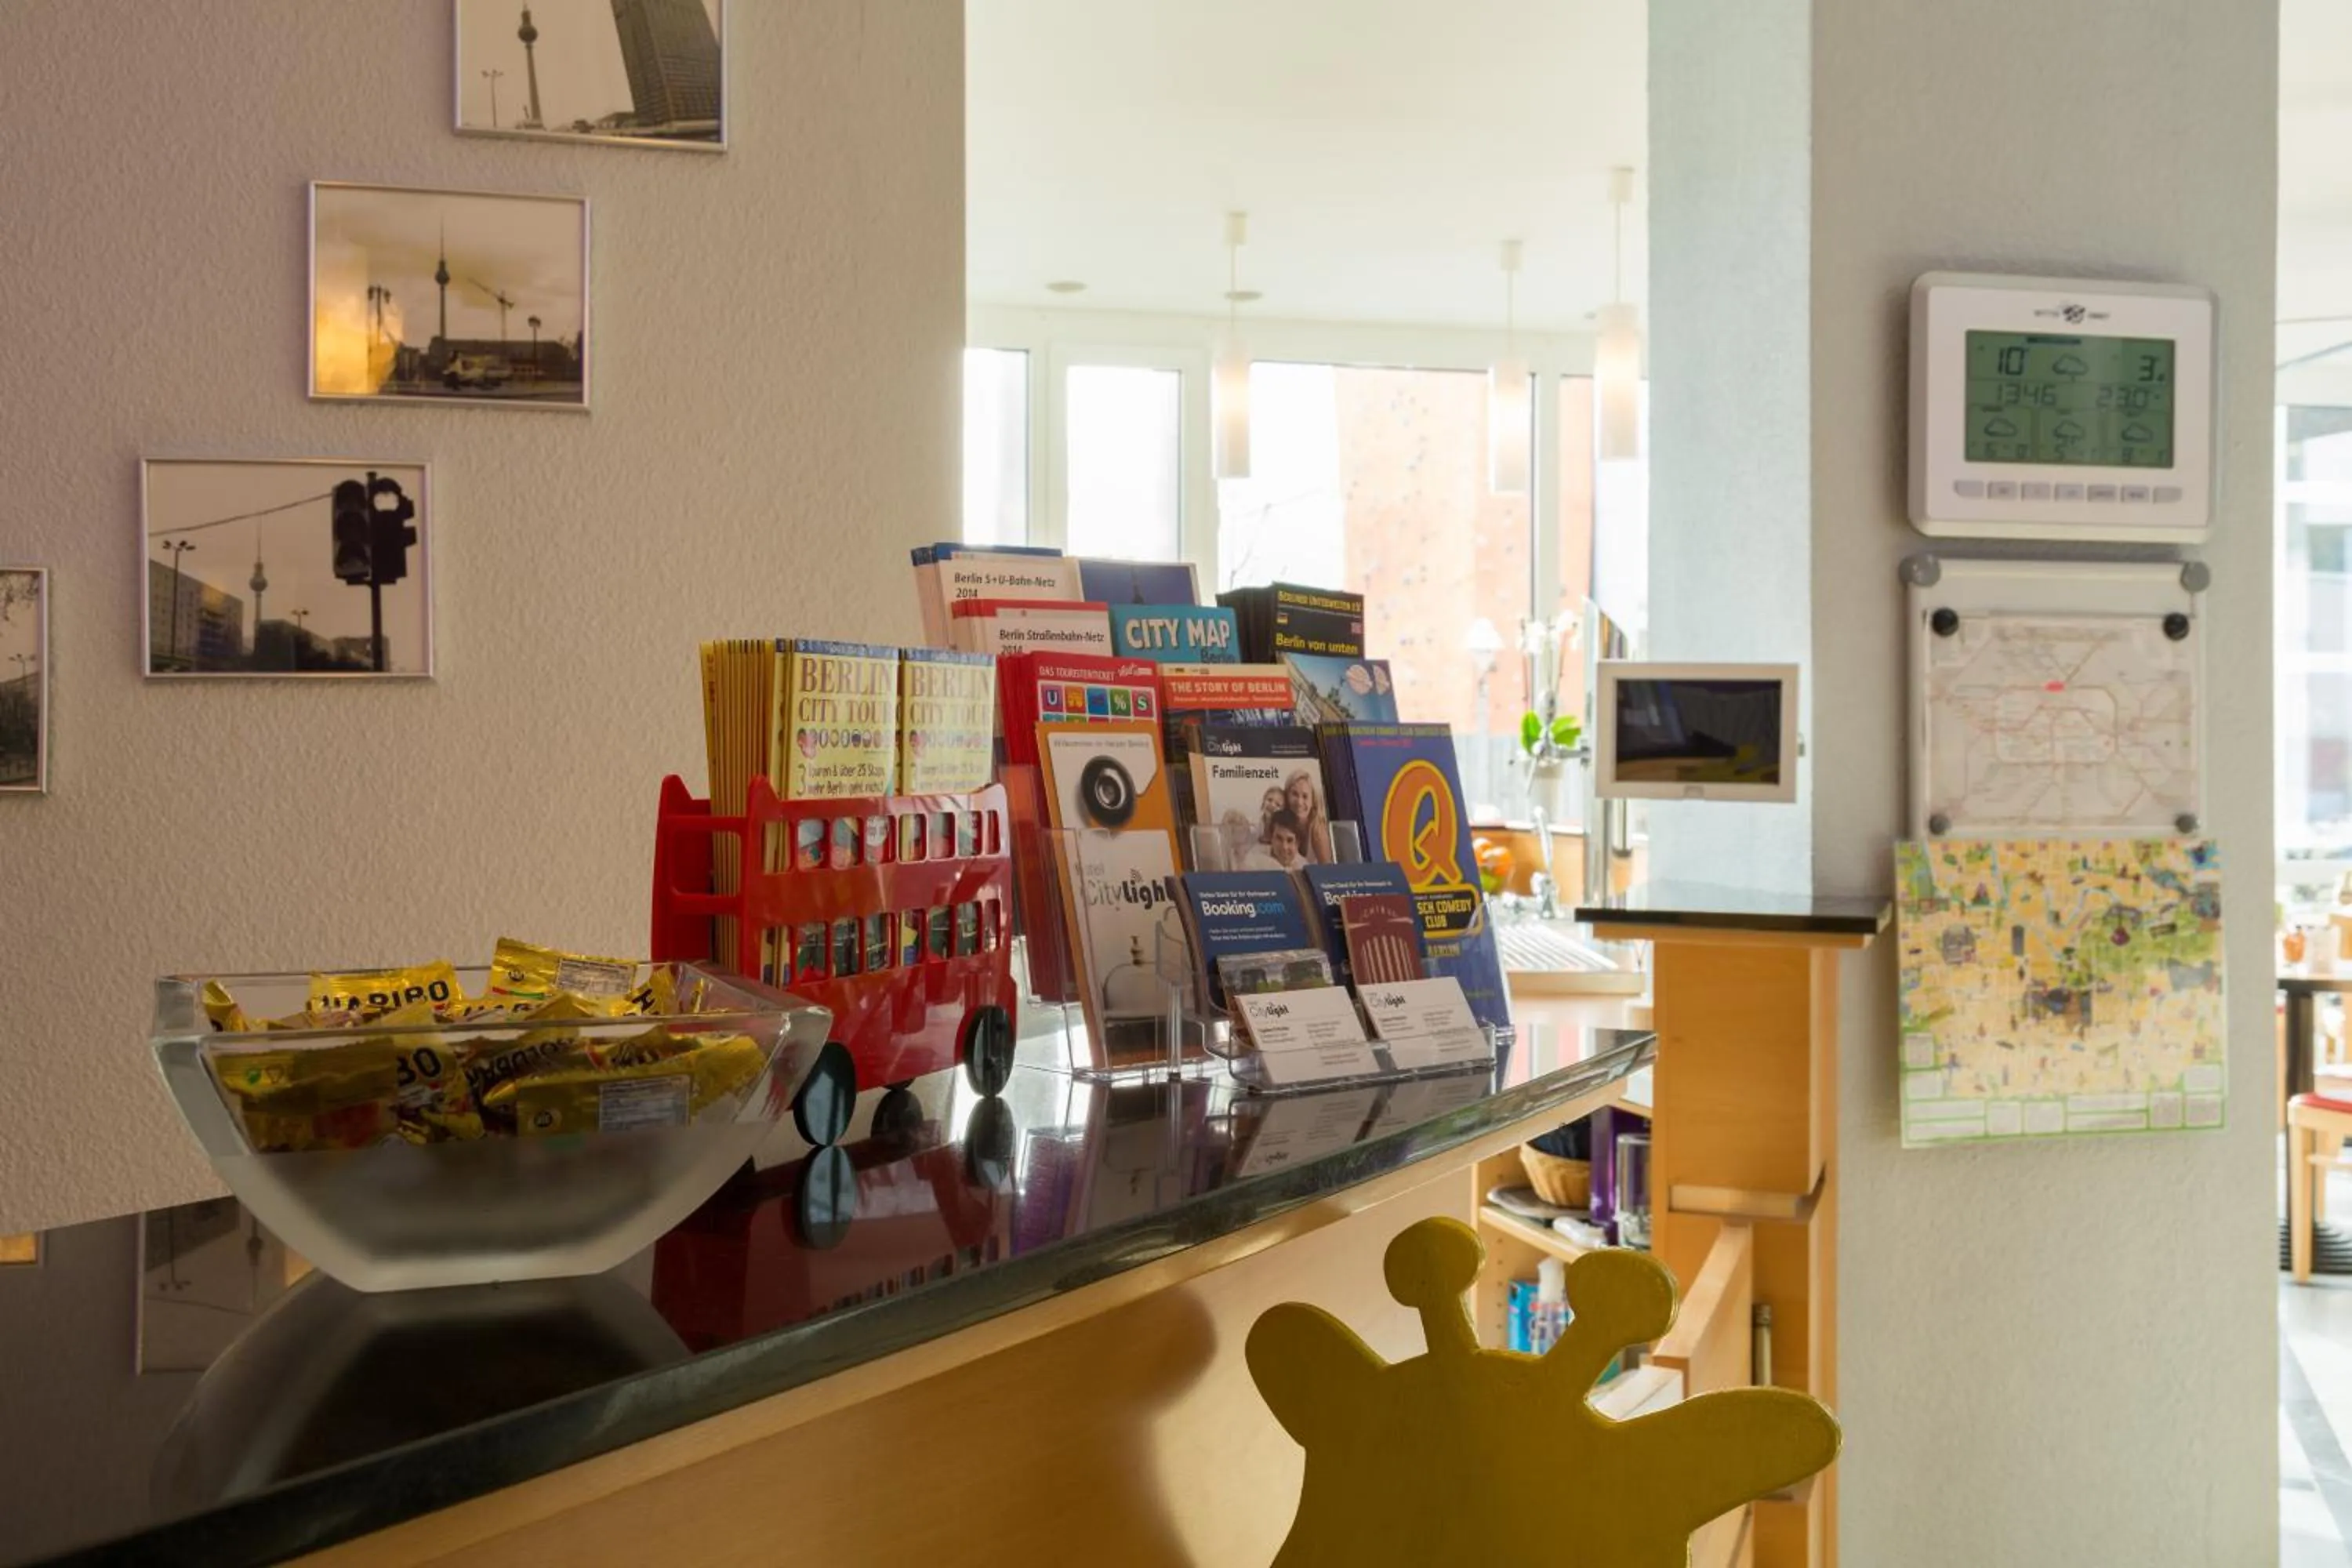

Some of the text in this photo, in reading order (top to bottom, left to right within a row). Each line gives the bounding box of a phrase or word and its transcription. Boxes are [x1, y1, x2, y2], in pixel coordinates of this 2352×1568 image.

[954, 572, 1055, 587] Berlin S+U-Bahn-Netz
[956, 587, 978, 598] 2014
[999, 629, 1105, 642] Berlin Straßenbahn-Netz
[1126, 618, 1230, 649] CITY MAP
[1276, 632, 1359, 655] Berlin von unten
[1200, 648, 1236, 663] Berlin
[800, 658, 892, 695] BERLIN
[910, 665, 990, 699] BERLIN
[1171, 681, 1287, 694] THE STORY OF BERLIN
[798, 697, 895, 724] CITY TOUR
[1212, 765, 1279, 779] Familienzeit
[1201, 901, 1286, 918] Booking.com
[1436, 898, 1472, 913] COMEDY
[1425, 915, 1447, 928] CLUB
